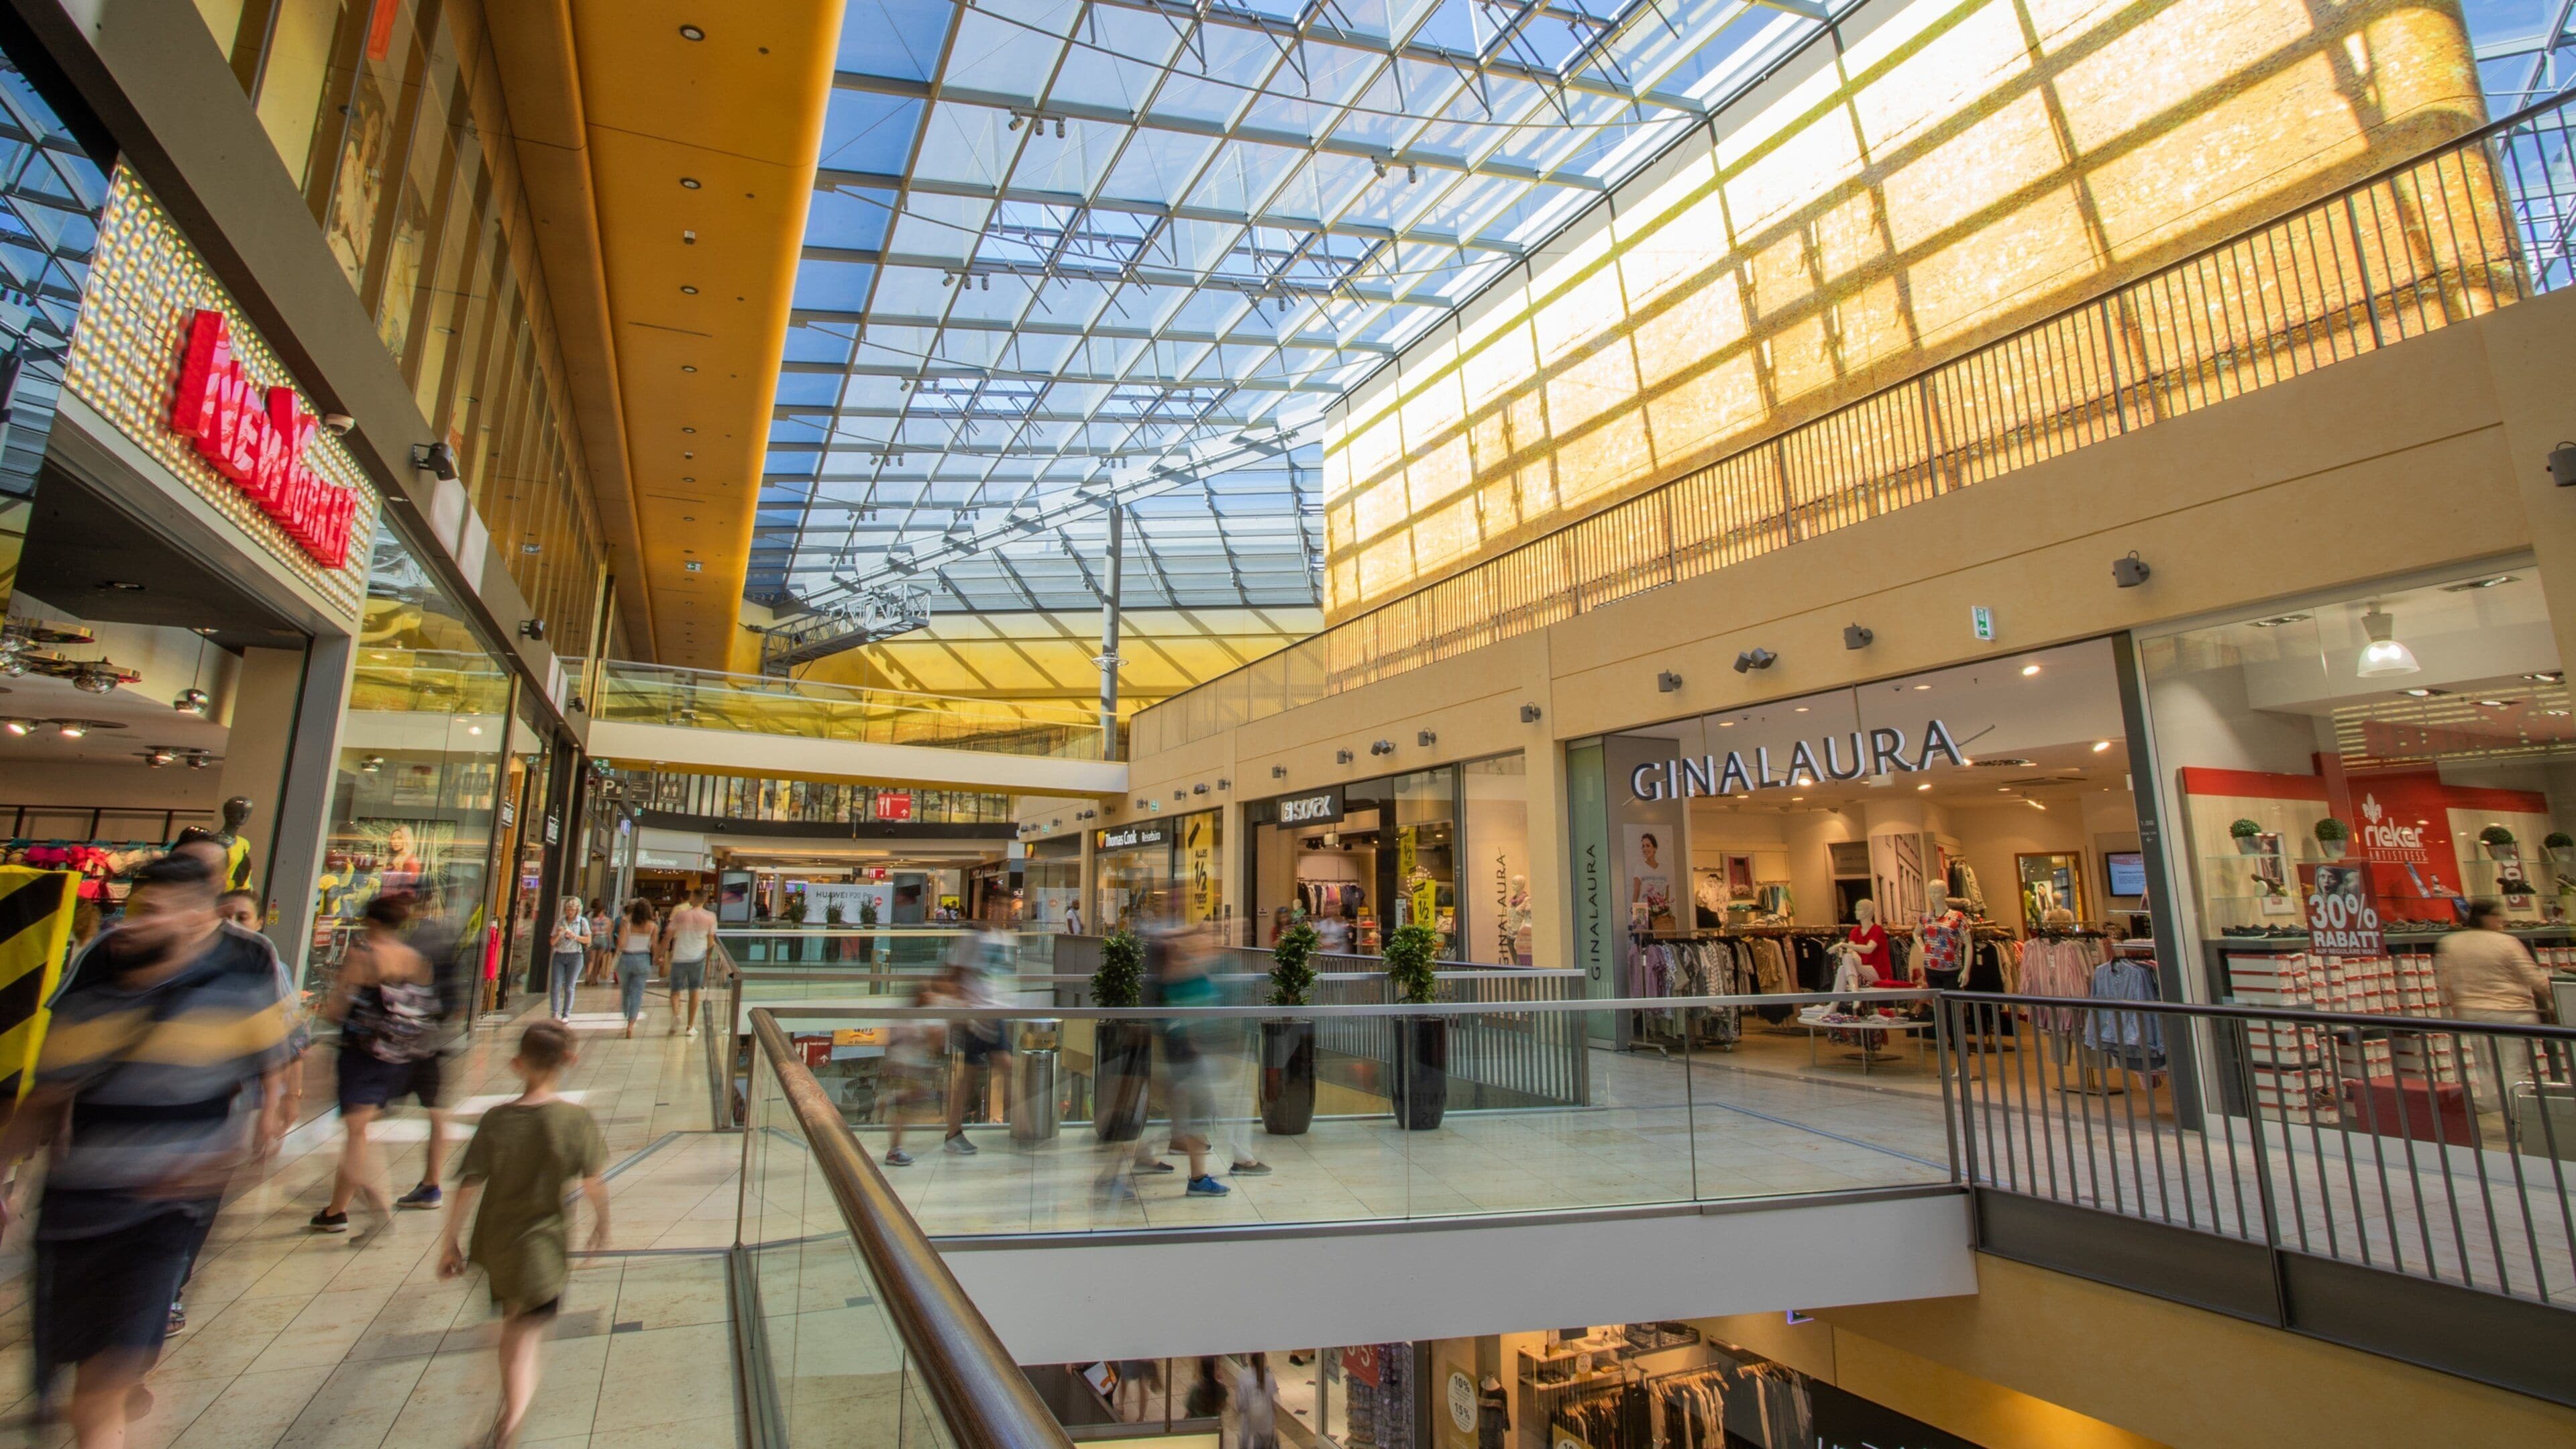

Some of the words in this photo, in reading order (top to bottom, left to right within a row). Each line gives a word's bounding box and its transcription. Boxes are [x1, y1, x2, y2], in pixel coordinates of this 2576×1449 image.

[1630, 719, 1966, 802] GINALAURA
[603, 780, 615, 794] P
[1105, 833, 1124, 847] Thomas
[1124, 829, 1138, 845] Cook
[2365, 817, 2424, 848] rieker
[1496, 853, 1509, 966] GINALAURA
[1587, 844, 1601, 981] GINALAURA
[2309, 893, 2377, 929] 30%
[2312, 930, 2380, 948] RABATT
[1454, 1375, 1470, 1393] 10%
[1454, 1402, 1470, 1421] 15%
